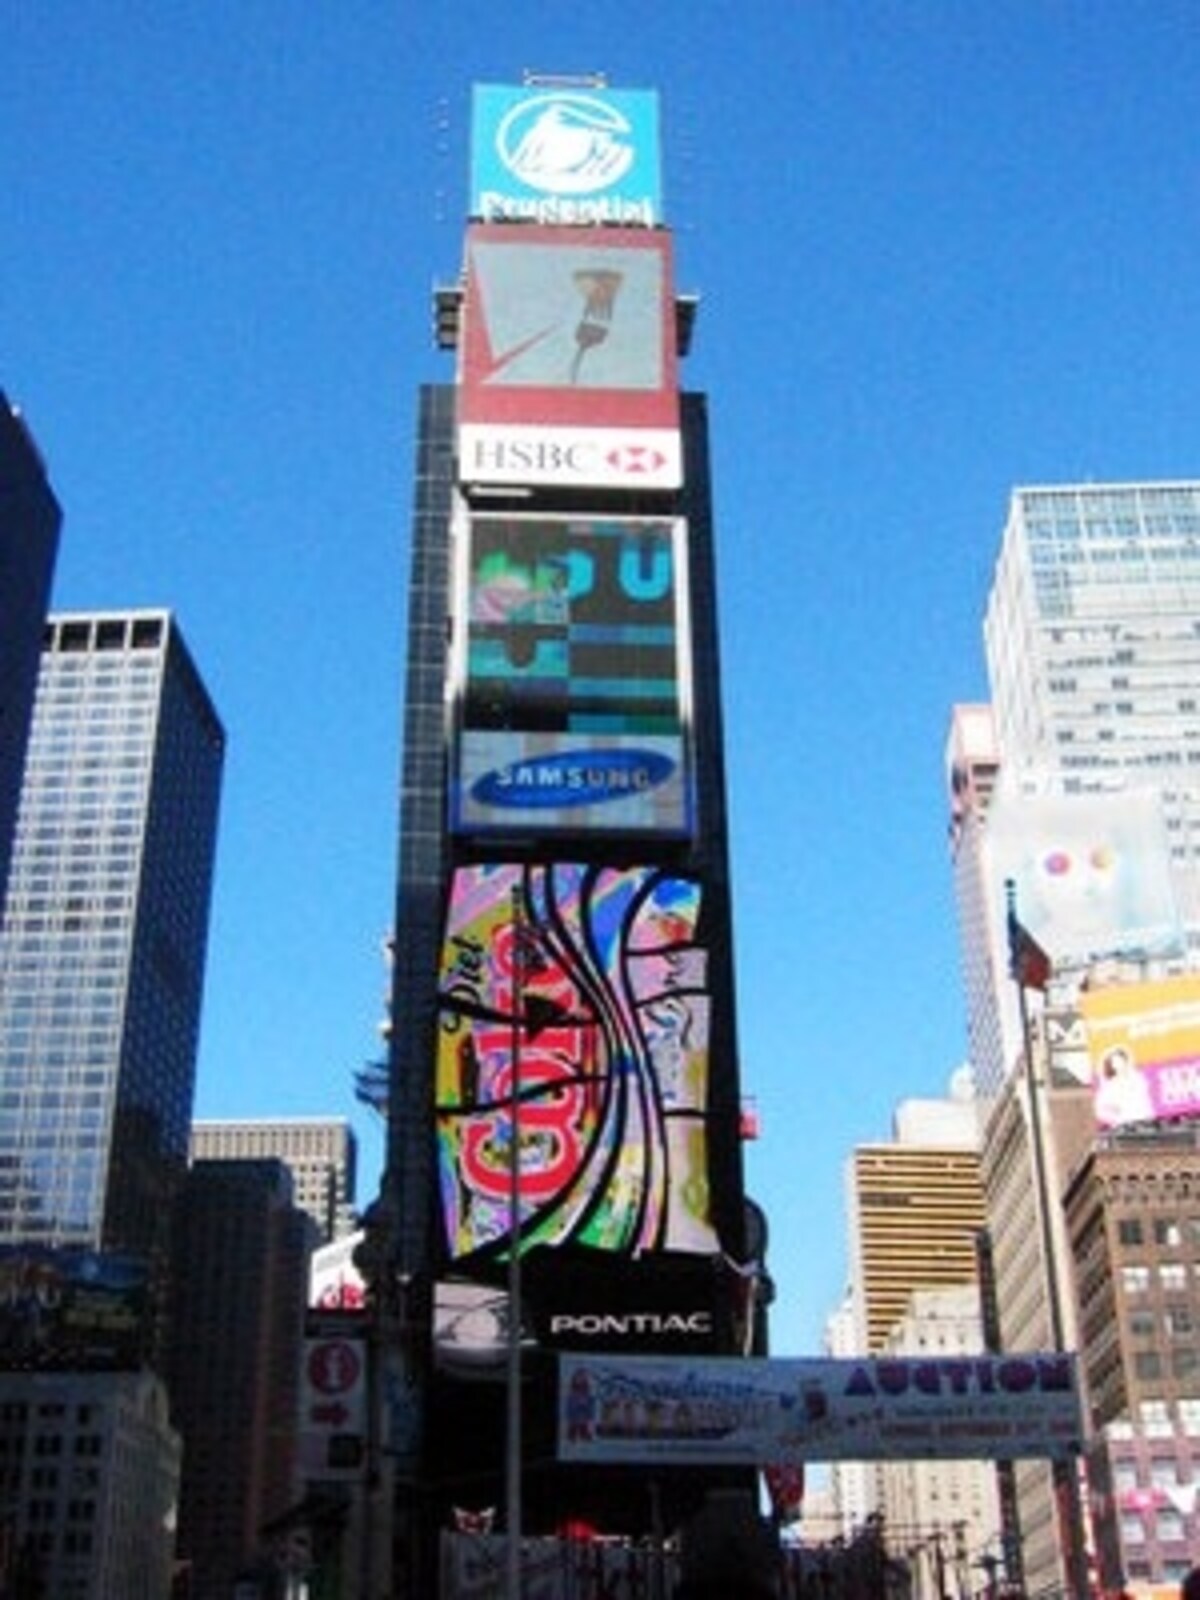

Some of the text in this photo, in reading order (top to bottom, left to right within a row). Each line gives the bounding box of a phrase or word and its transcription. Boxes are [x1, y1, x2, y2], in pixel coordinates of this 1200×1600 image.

[479, 190, 654, 228] Prudential
[474, 438, 594, 473] HSBC
[495, 764, 652, 791] SAMSUNG
[550, 1311, 712, 1335] PONTIAC
[843, 1359, 1074, 1397] AUCTION
